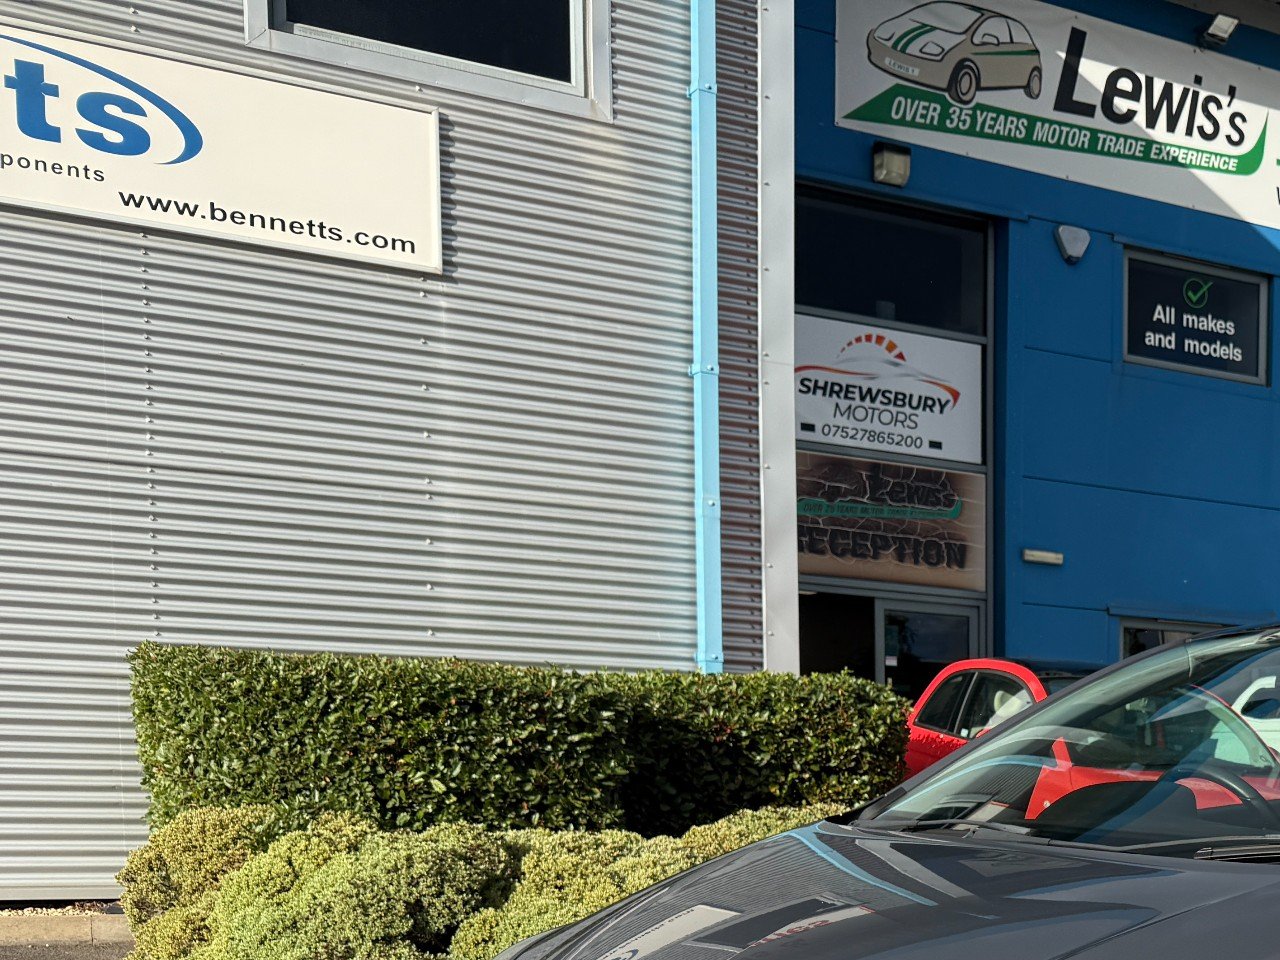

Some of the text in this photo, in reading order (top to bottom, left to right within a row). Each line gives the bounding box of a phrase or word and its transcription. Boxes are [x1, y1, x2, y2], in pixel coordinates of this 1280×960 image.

[1053, 26, 1247, 147] Lewis's
[891, 97, 1239, 172] OVER 35 YEARS MOTOR TRADE EXPERIENCE
[118, 189, 417, 254] www.bennetts.com
[1152, 304, 1236, 336] All makes
[1144, 331, 1243, 362] and models
[798, 377, 951, 415] SHREWSBURY
[833, 402, 919, 430] MOTORS
[821, 424, 924, 449] 07527865200
